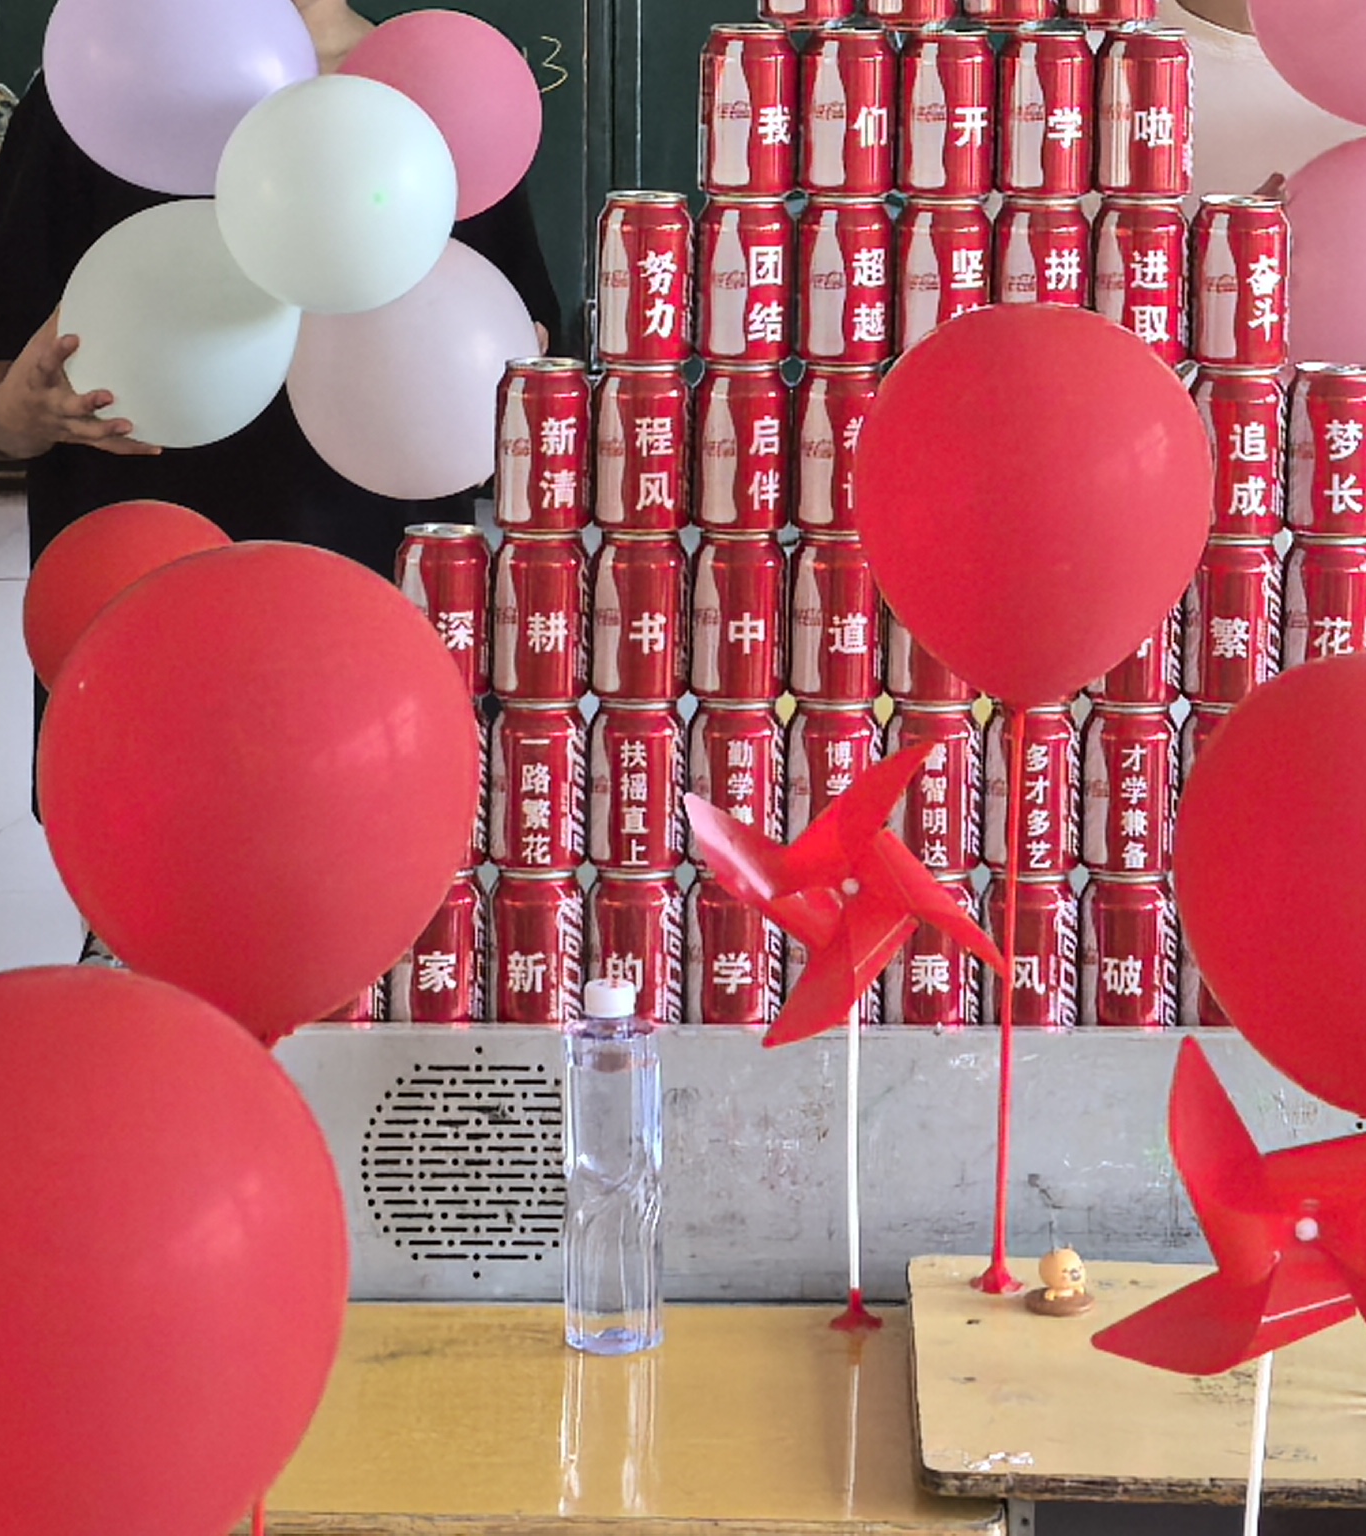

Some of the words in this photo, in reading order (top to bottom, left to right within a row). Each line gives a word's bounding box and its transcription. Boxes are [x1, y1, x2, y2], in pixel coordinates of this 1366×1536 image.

[637, 250, 677, 339] 努力
[747, 245, 784, 342] 团结
[851, 247, 886, 342] 超越
[1130, 249, 1169, 345] 进取
[1248, 254, 1281, 342] 奋斗
[520, 738, 551, 865] 一路繁花
[620, 740, 650, 866] 扶摇直上
[1025, 743, 1052, 870] 多才多艺
[1121, 744, 1148, 870] 才学兼备
[417, 950, 457, 993] 家
[506, 951, 547, 994] 新
[712, 952, 754, 995] 学
[910, 953, 951, 994] 乘
[1102, 956, 1143, 997] 破
